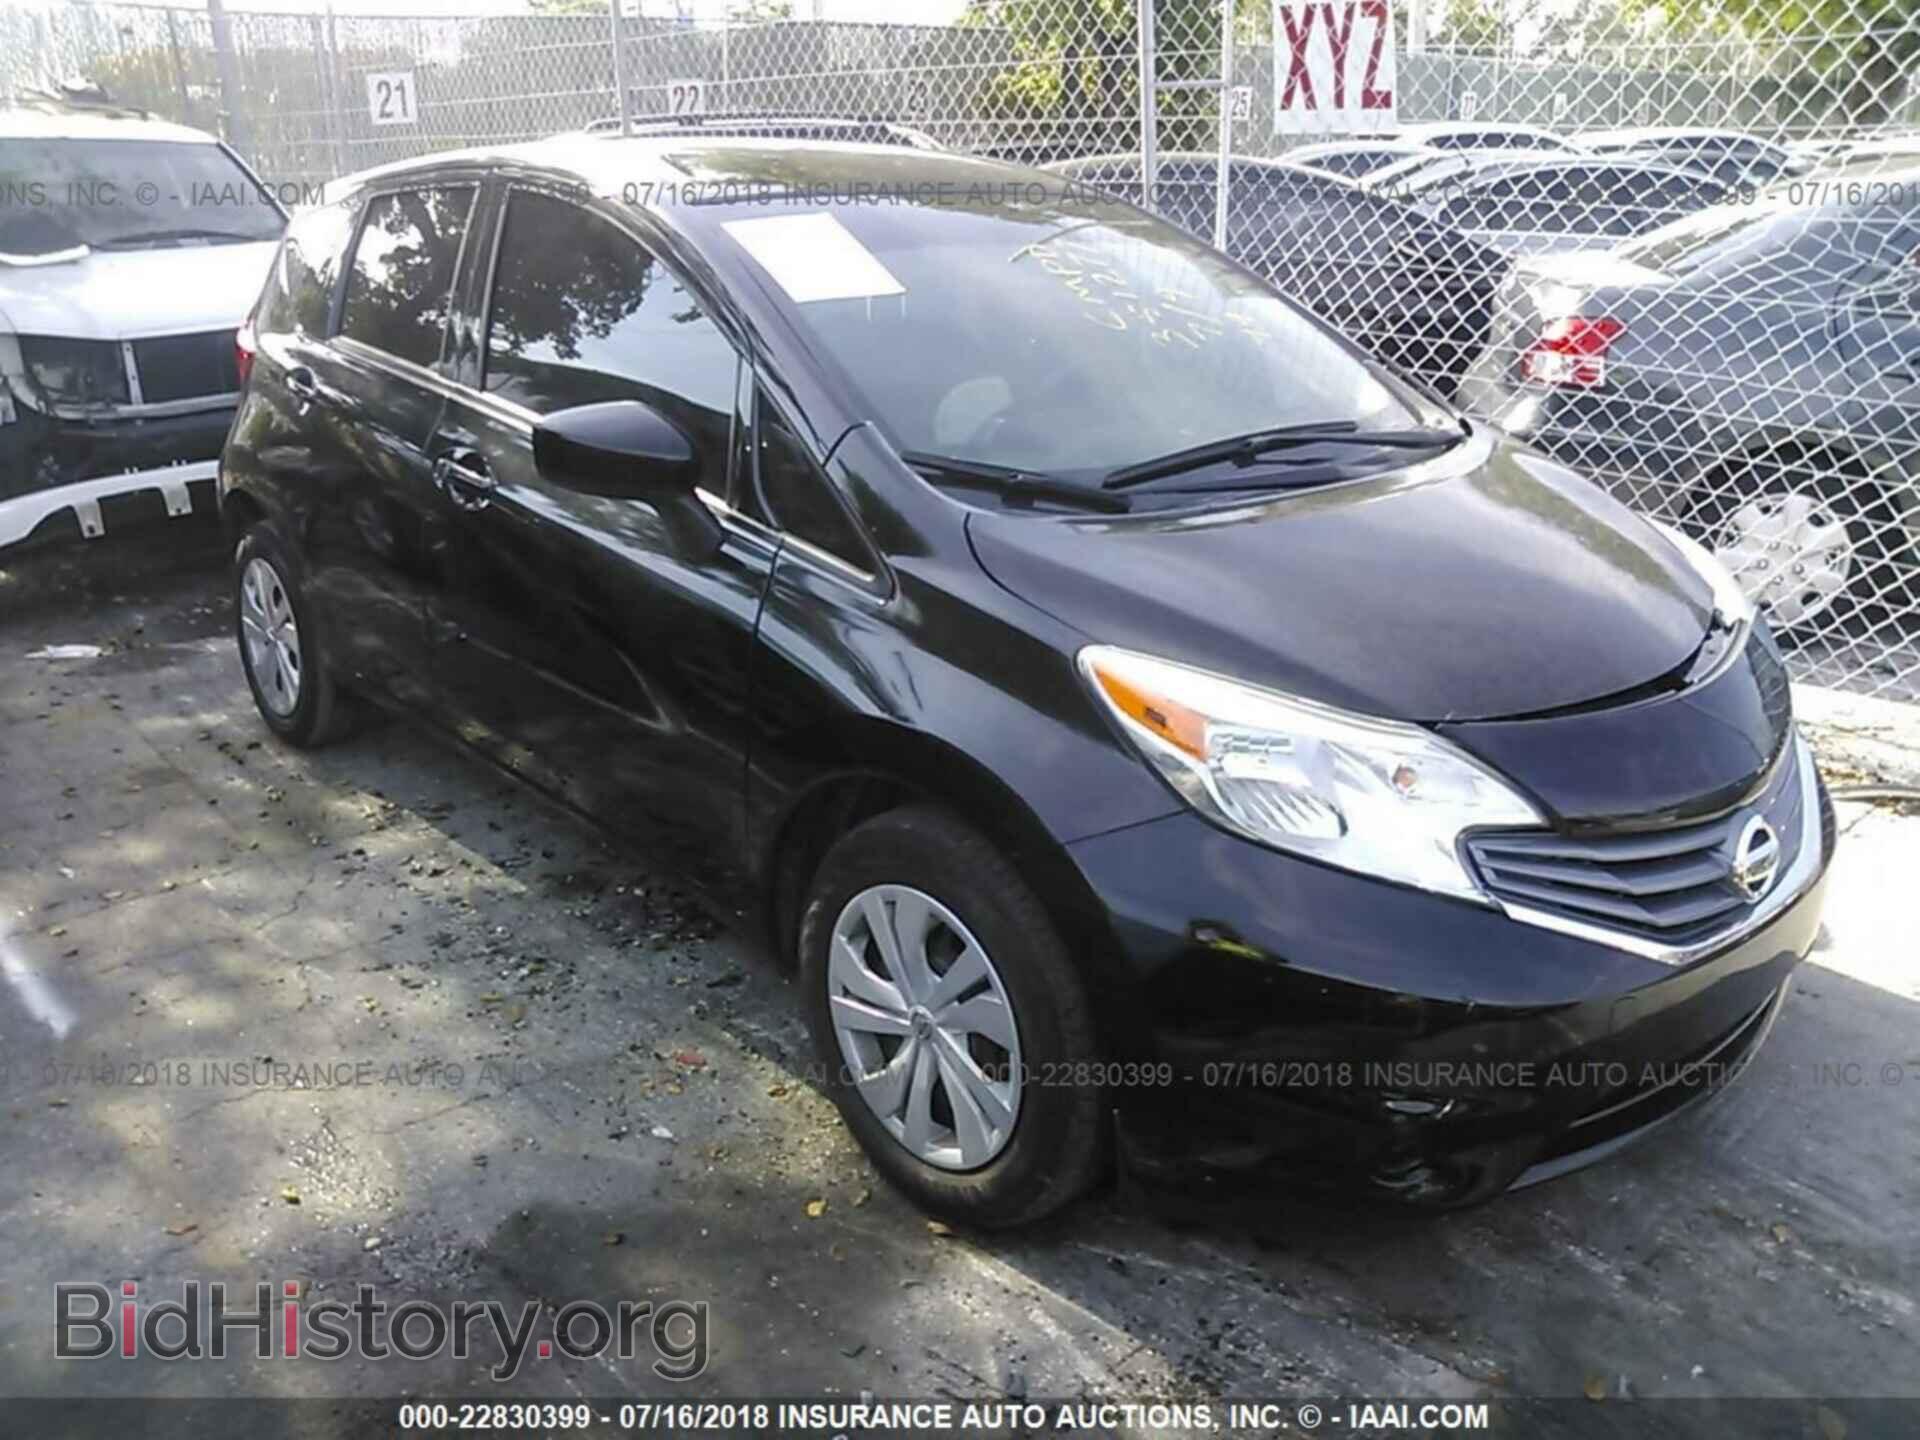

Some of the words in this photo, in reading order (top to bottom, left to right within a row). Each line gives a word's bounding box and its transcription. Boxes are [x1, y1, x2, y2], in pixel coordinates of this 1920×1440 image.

[1279, 1, 1393, 111] XYZ
[376, 79, 409, 118] 21
[672, 85, 700, 113] 22
[1232, 90, 1248, 117] 25
